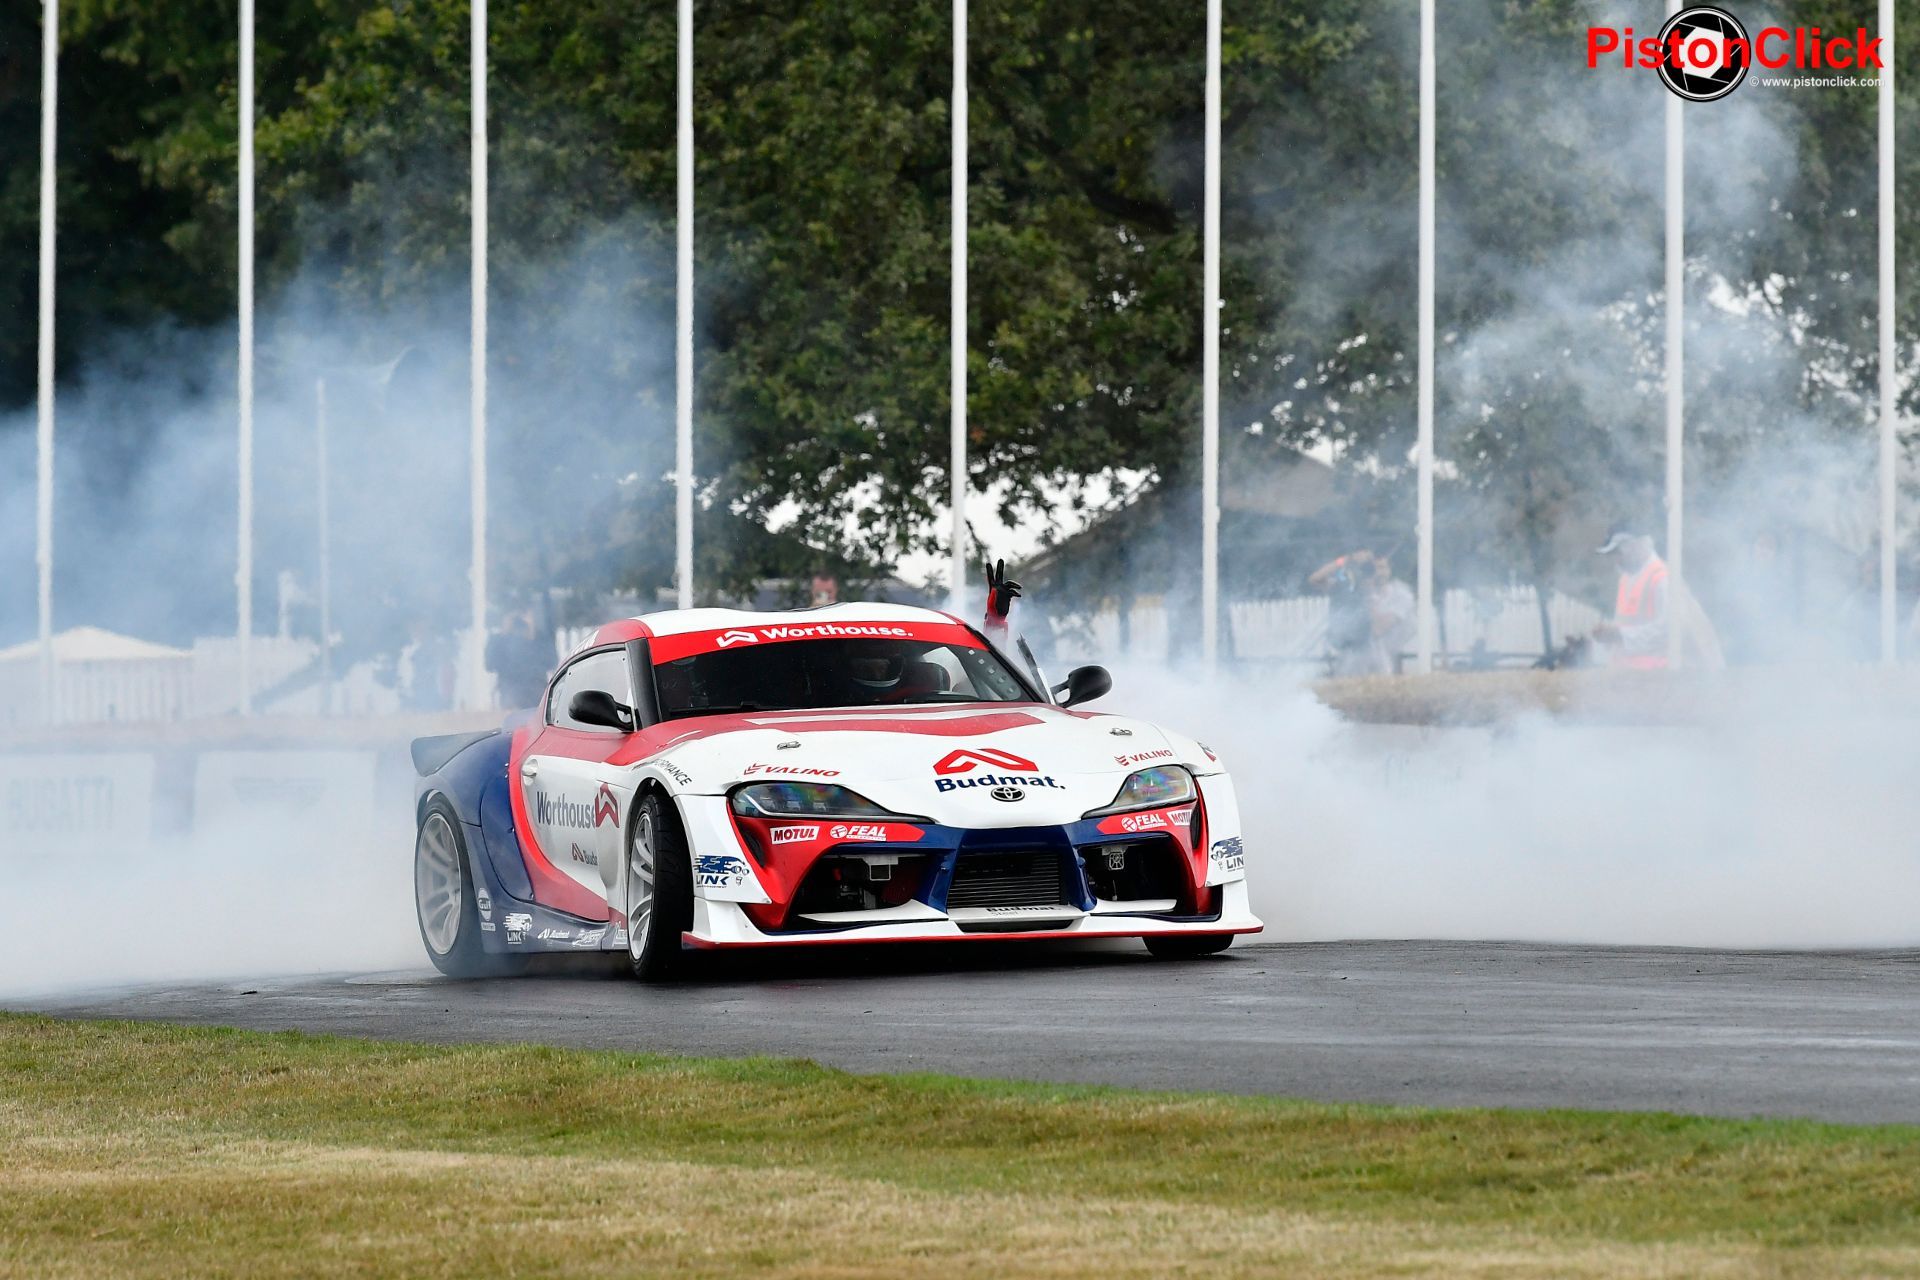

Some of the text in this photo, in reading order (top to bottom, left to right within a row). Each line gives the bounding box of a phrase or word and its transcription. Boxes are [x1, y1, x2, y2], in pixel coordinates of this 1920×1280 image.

[760, 624, 914, 639] Worthouse.
[1129, 749, 1173, 762] VALINO
[765, 766, 841, 777] VALINO
[935, 774, 1066, 792] Budmat.
[1135, 813, 1166, 826] FEAL
[774, 828, 816, 842] MOTUL
[848, 825, 886, 837] FEAL
[696, 875, 730, 886] LINK
